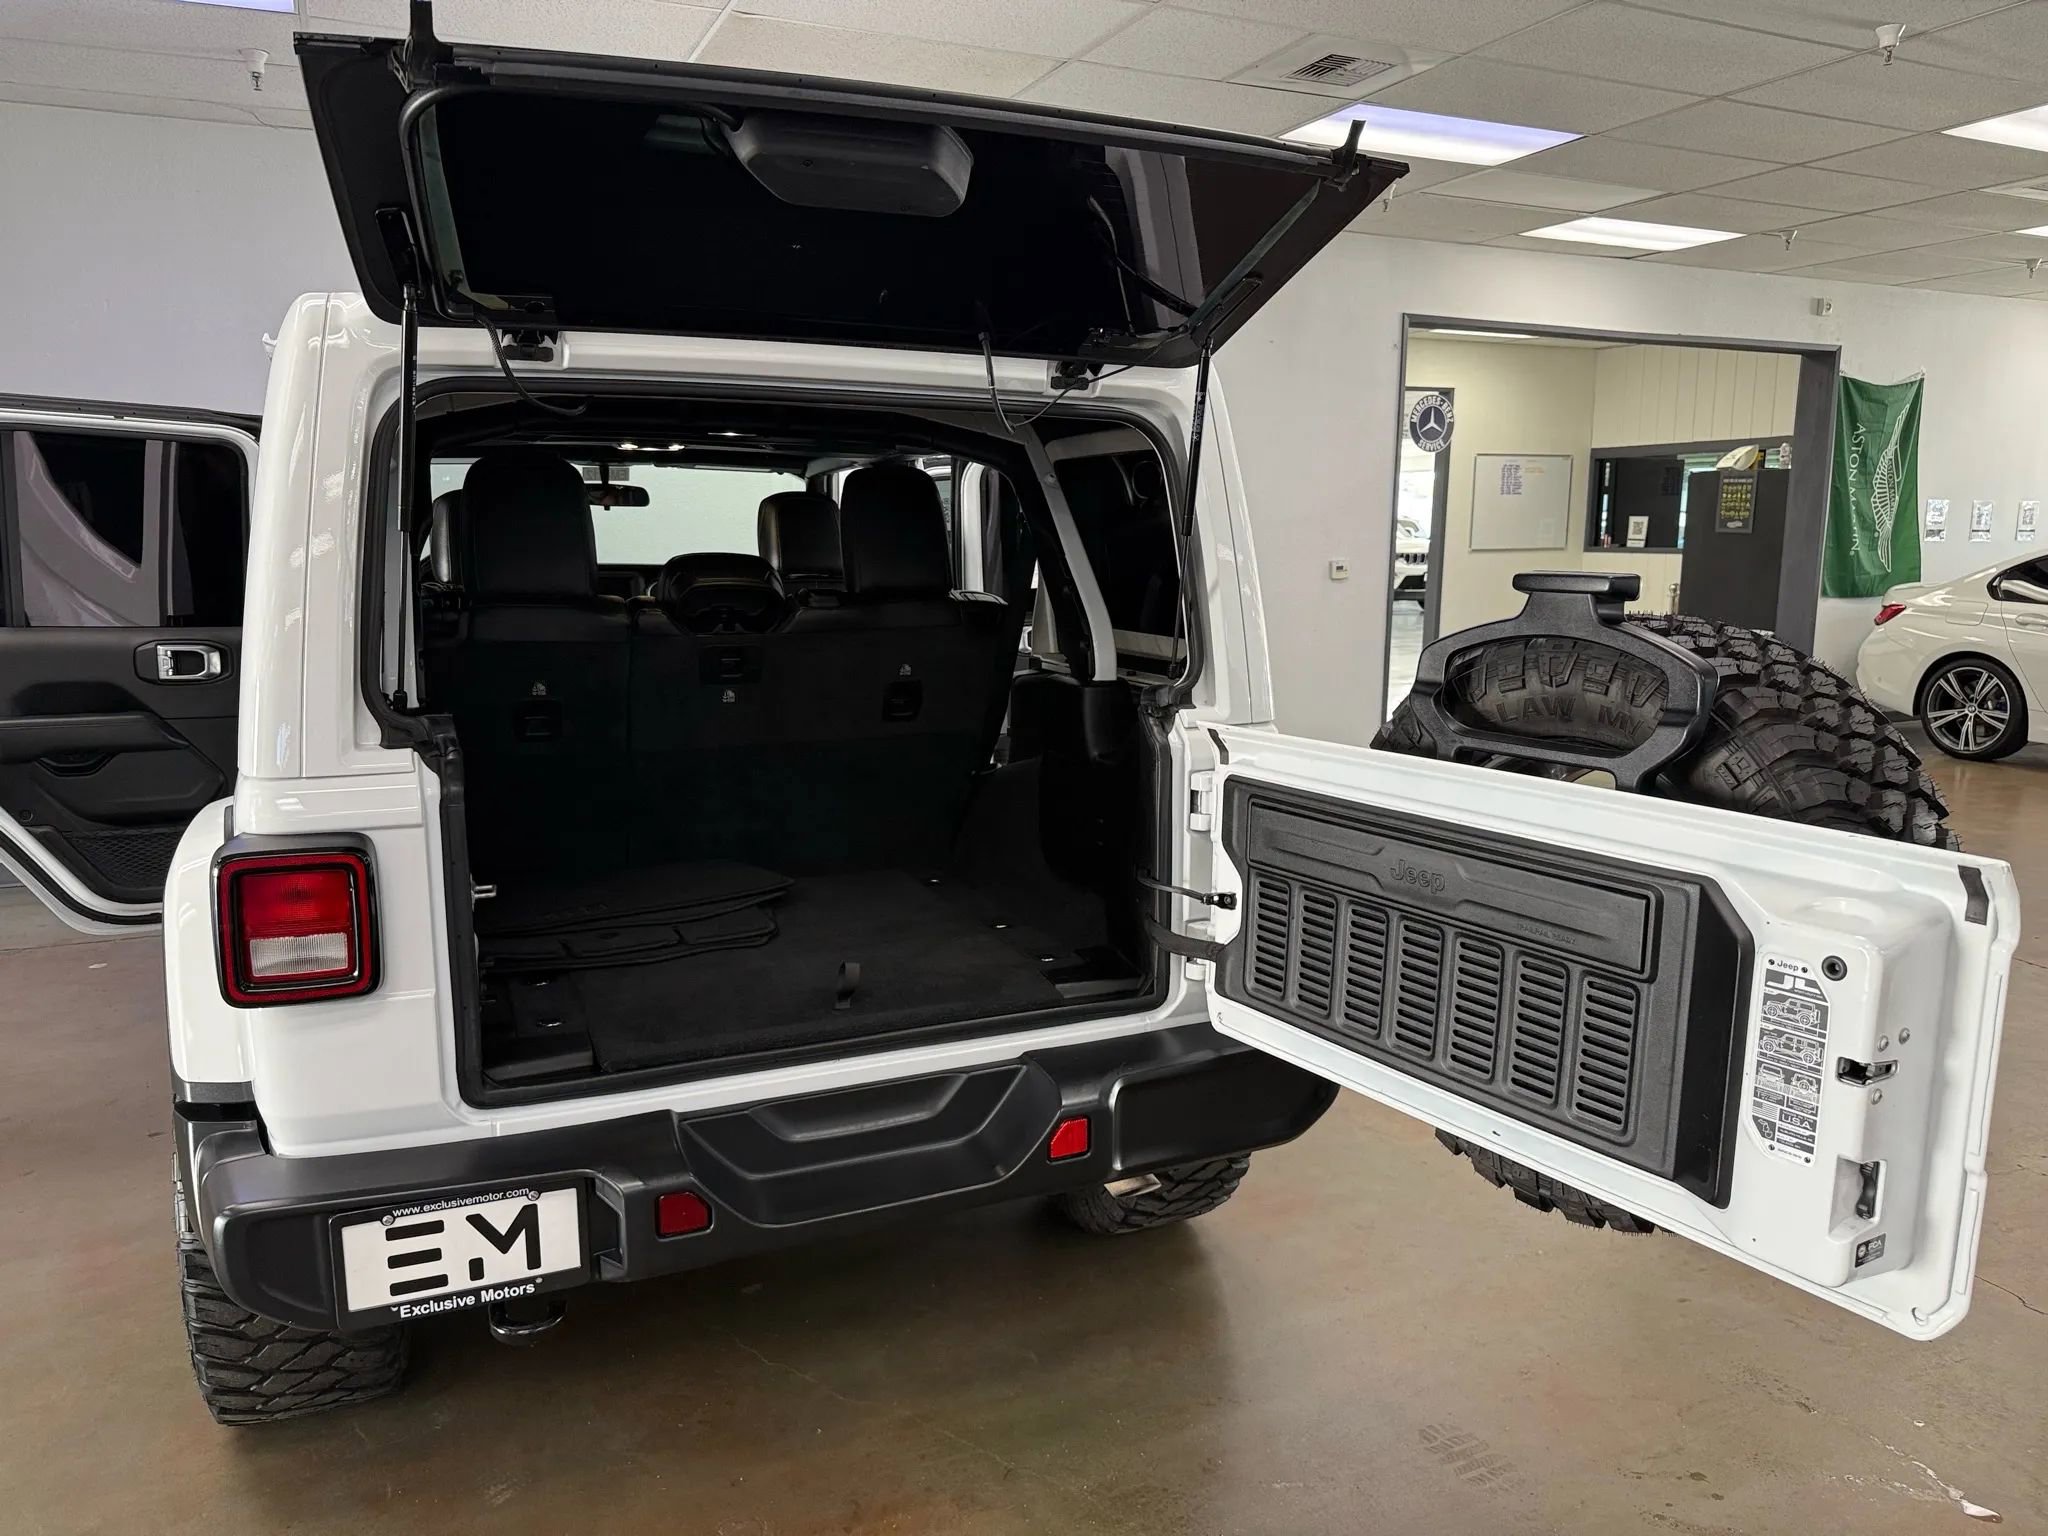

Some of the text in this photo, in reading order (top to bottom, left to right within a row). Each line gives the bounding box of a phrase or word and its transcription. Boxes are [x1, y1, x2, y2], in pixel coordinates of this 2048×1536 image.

[1849, 423, 1866, 481] ASTON
[1390, 859, 1446, 894] Jeep
[1776, 960, 1799, 972] Jeep
[1766, 974, 1822, 995] JL
[392, 1187, 530, 1217] www.exclusivemotor.com
[400, 1282, 536, 1320] Exclusive Motors
